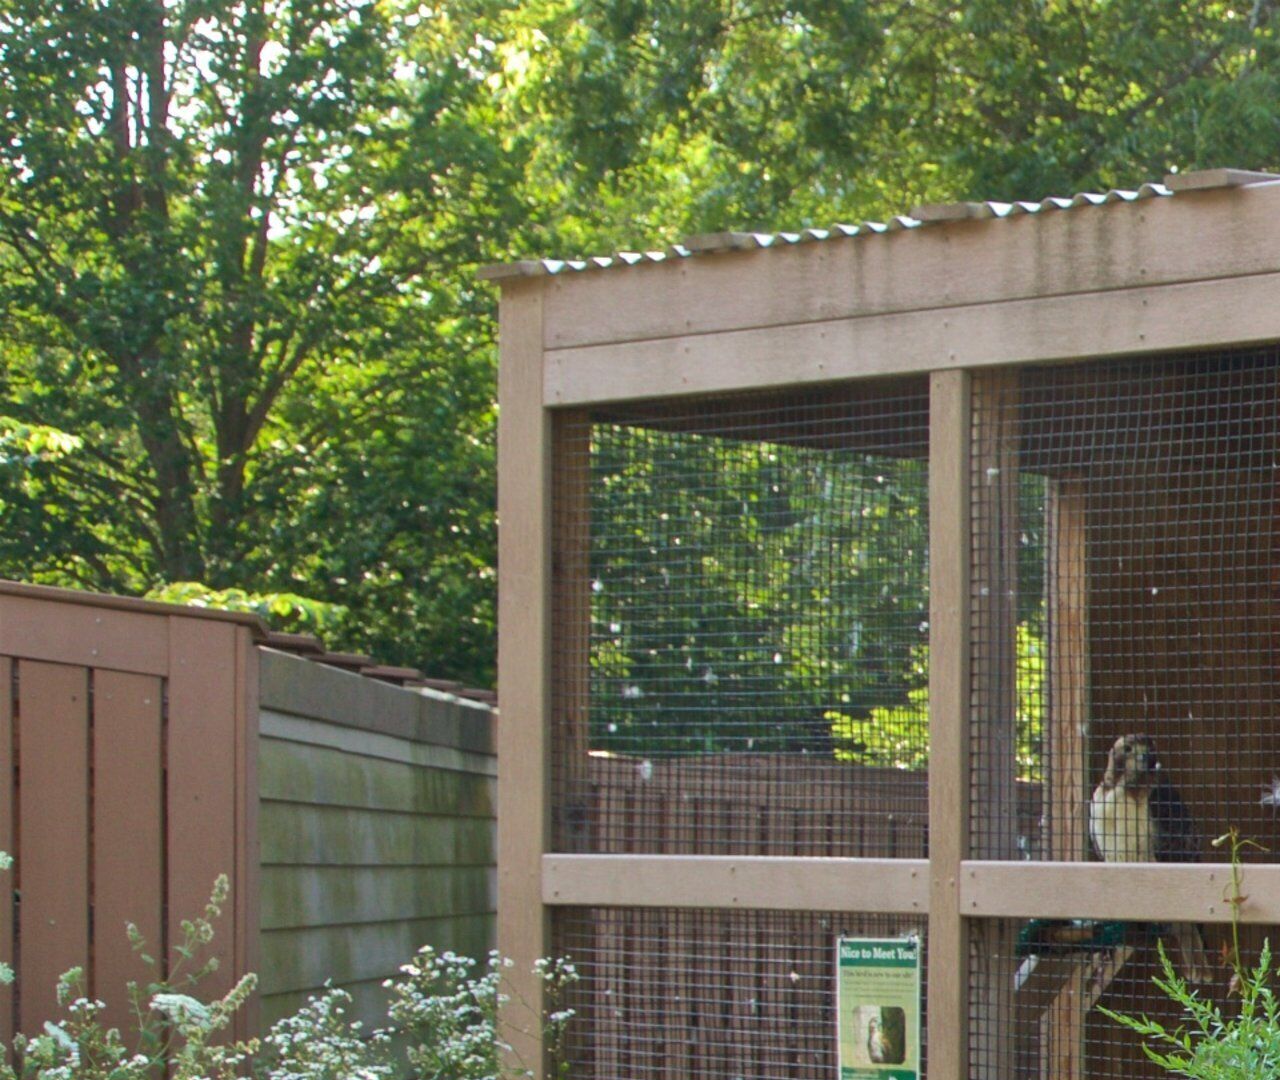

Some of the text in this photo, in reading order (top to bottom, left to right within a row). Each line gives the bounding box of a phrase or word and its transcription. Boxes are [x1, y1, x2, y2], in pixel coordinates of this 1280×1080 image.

[840, 946, 860, 958] Nice
[861, 948, 872, 959] to
[872, 947, 896, 959] Meet
